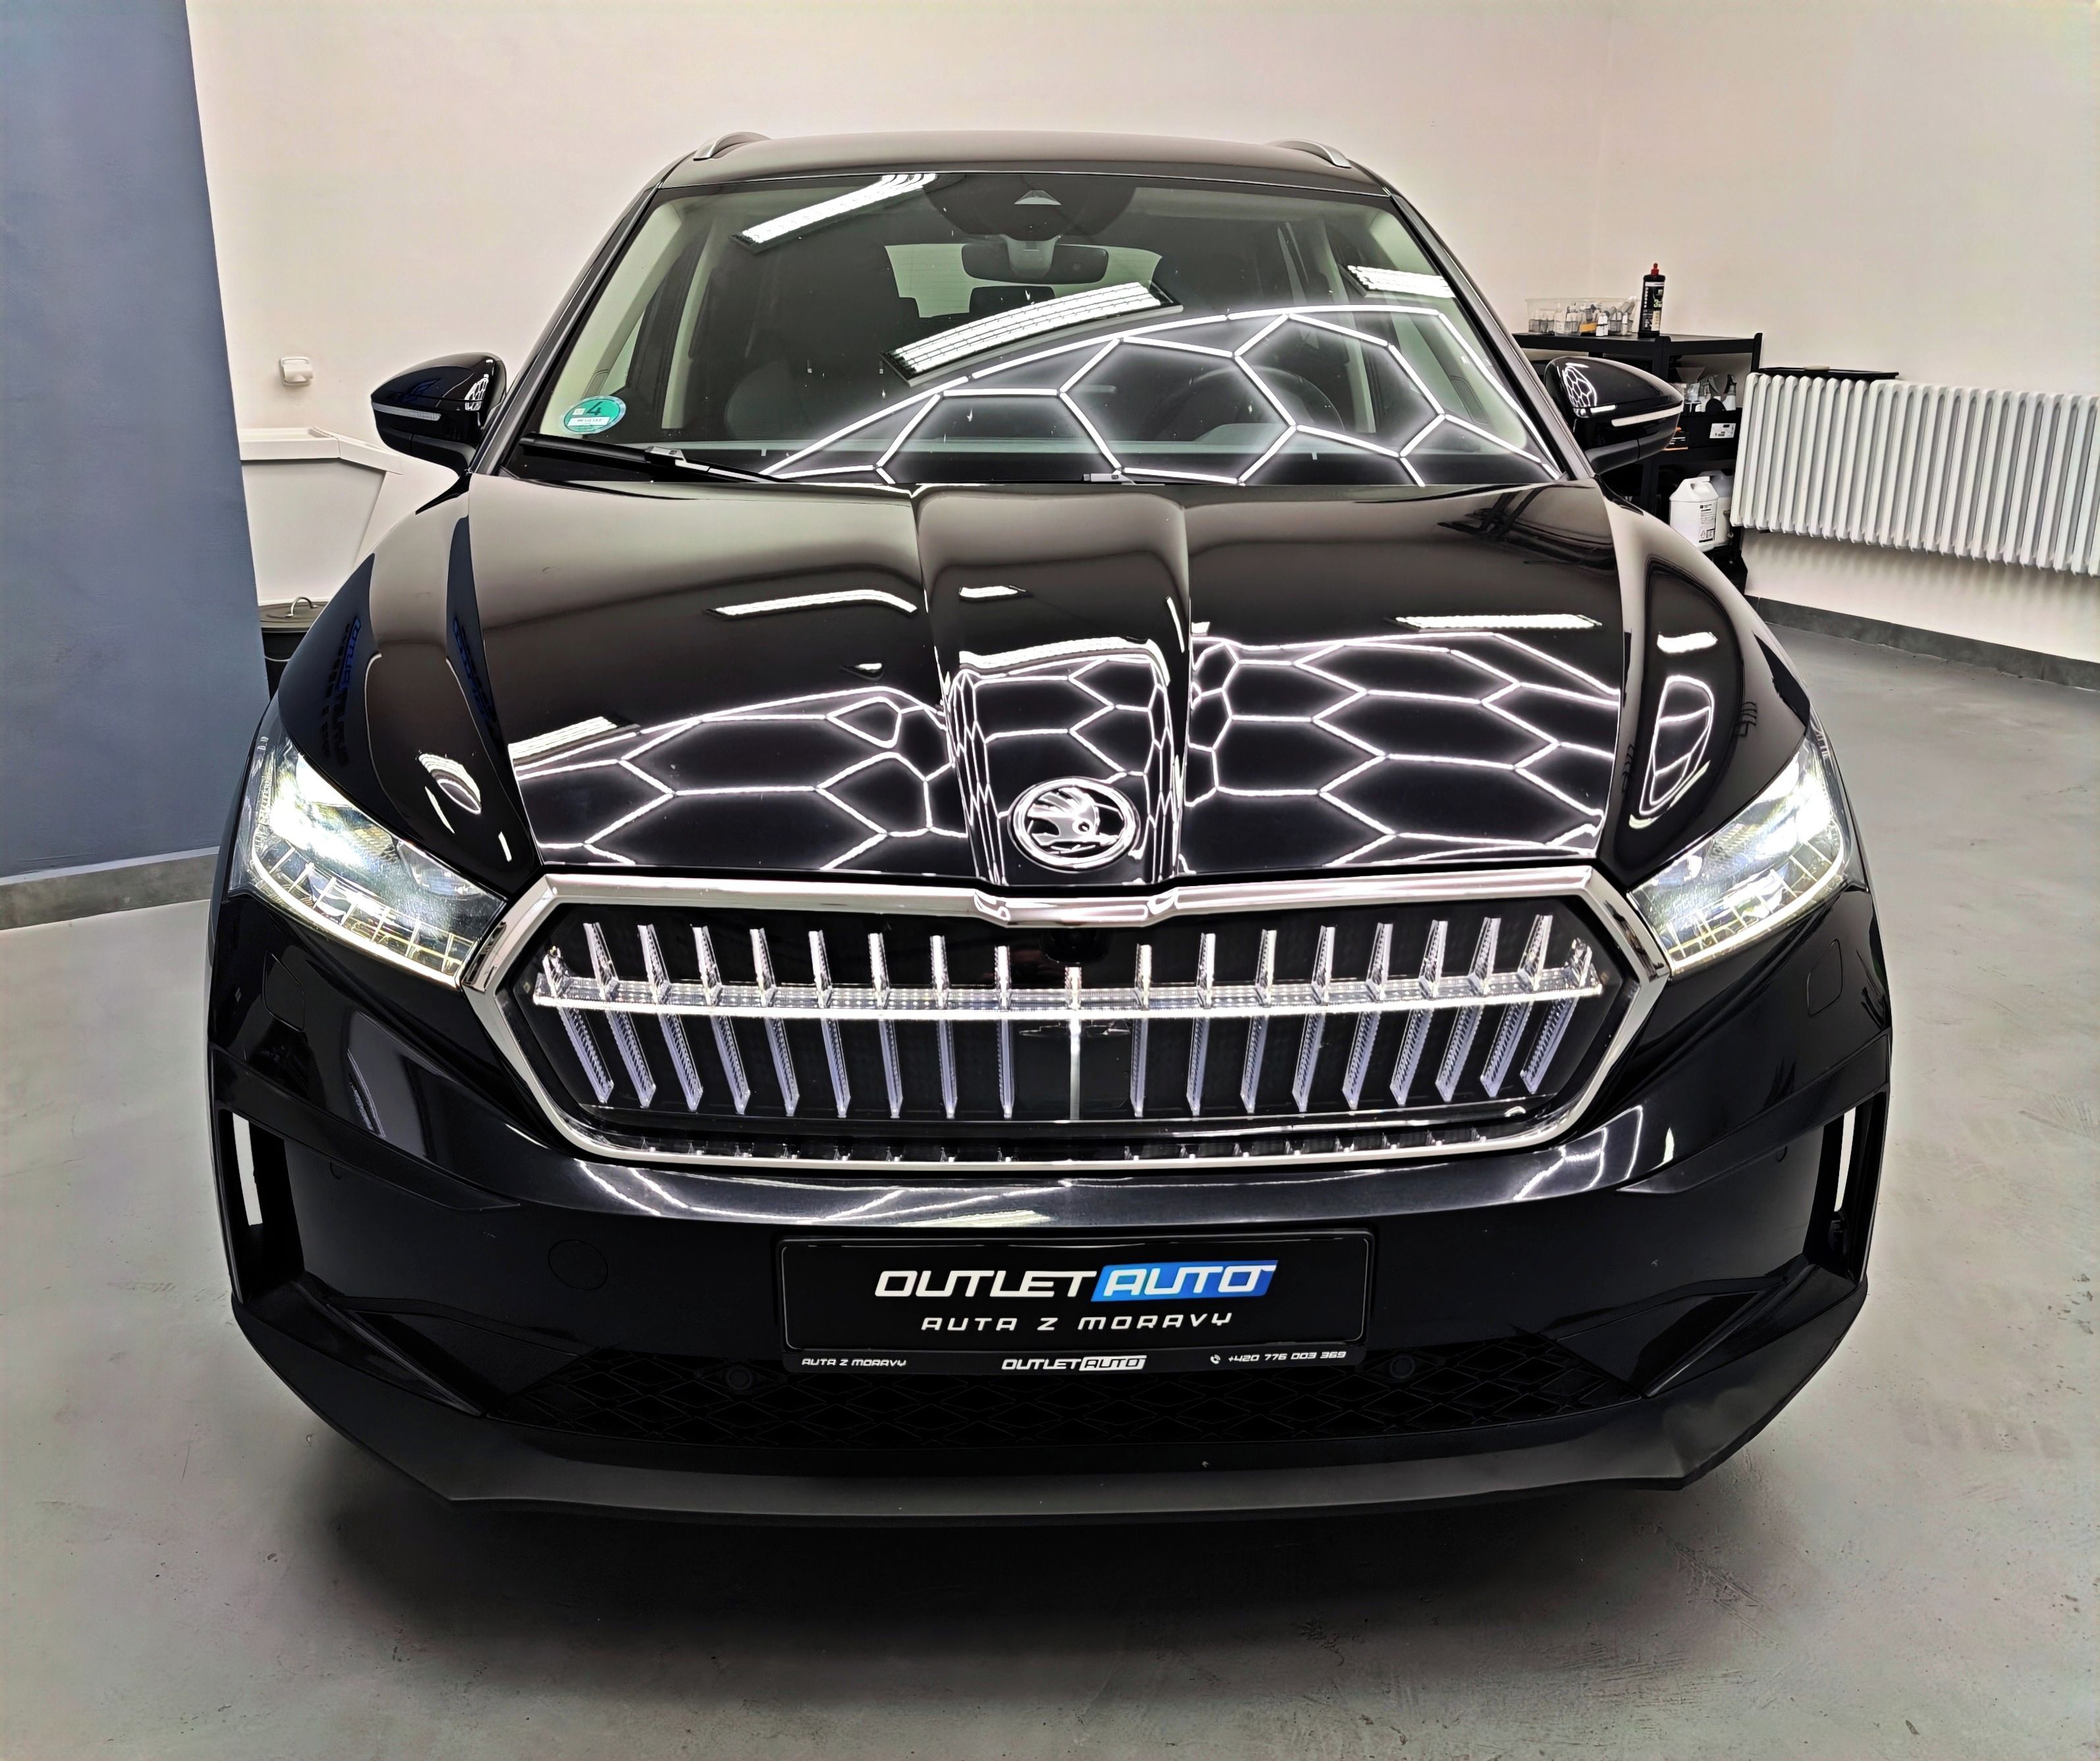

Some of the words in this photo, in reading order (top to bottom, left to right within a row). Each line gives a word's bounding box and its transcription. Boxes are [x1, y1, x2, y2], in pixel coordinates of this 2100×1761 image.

[586, 401, 603, 415] 4
[921, 1317, 1017, 1331] AUTA
[1037, 1317, 1059, 1331] Z
[1077, 1312, 1232, 1330] MORAVY
[1264, 1353, 1288, 1361] 776
[1290, 1352, 1317, 1360] 003
[851, 1358, 906, 1367] MORAVY
